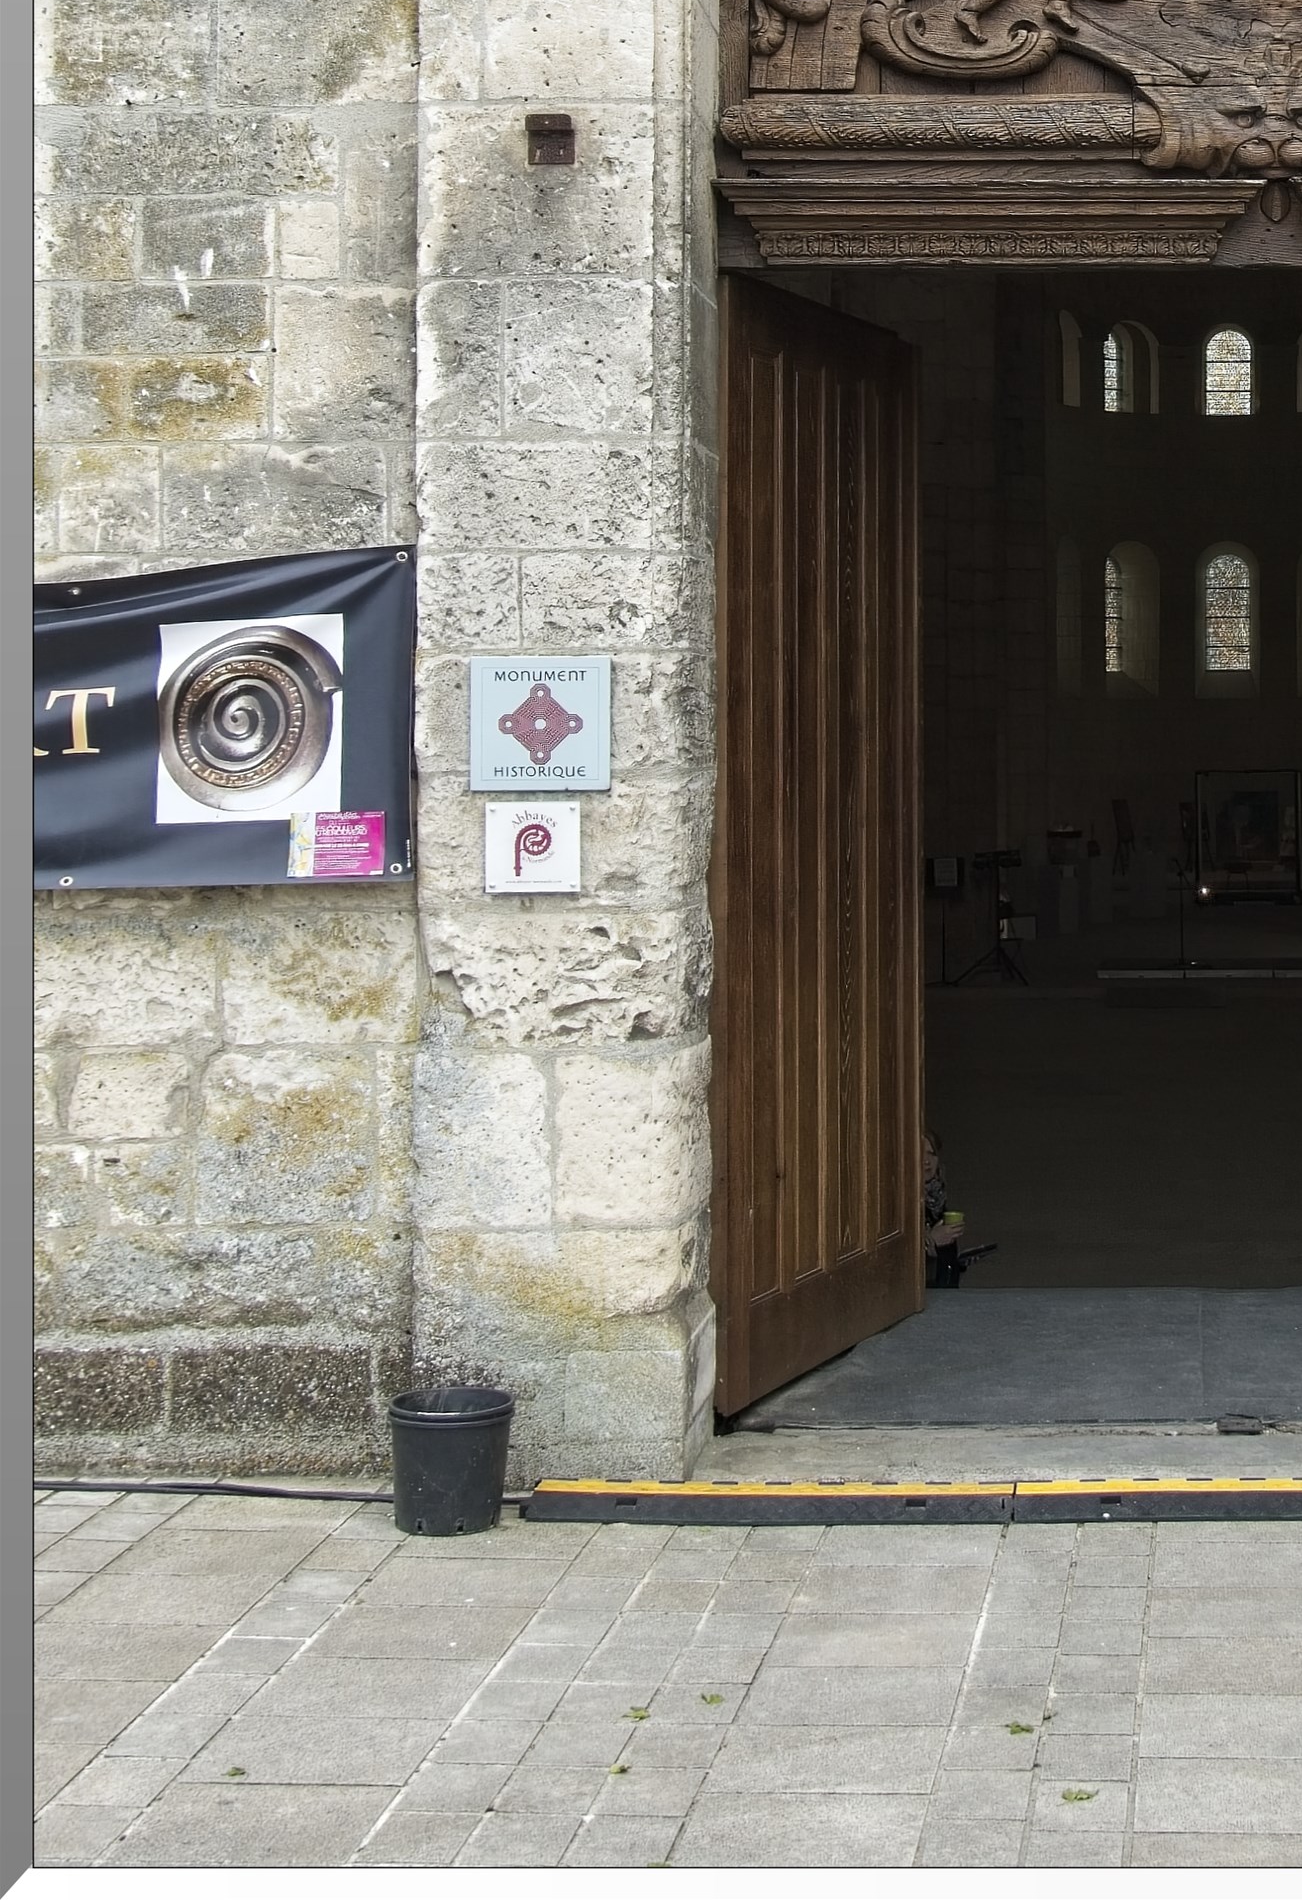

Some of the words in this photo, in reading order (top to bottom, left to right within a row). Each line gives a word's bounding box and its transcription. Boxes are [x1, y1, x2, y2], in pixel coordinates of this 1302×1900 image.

[494, 670, 587, 682] MONUMENT
[34, 686, 116, 757] T
[494, 766, 586, 778] HISTORIQUE
[511, 810, 558, 829] Abbayes
